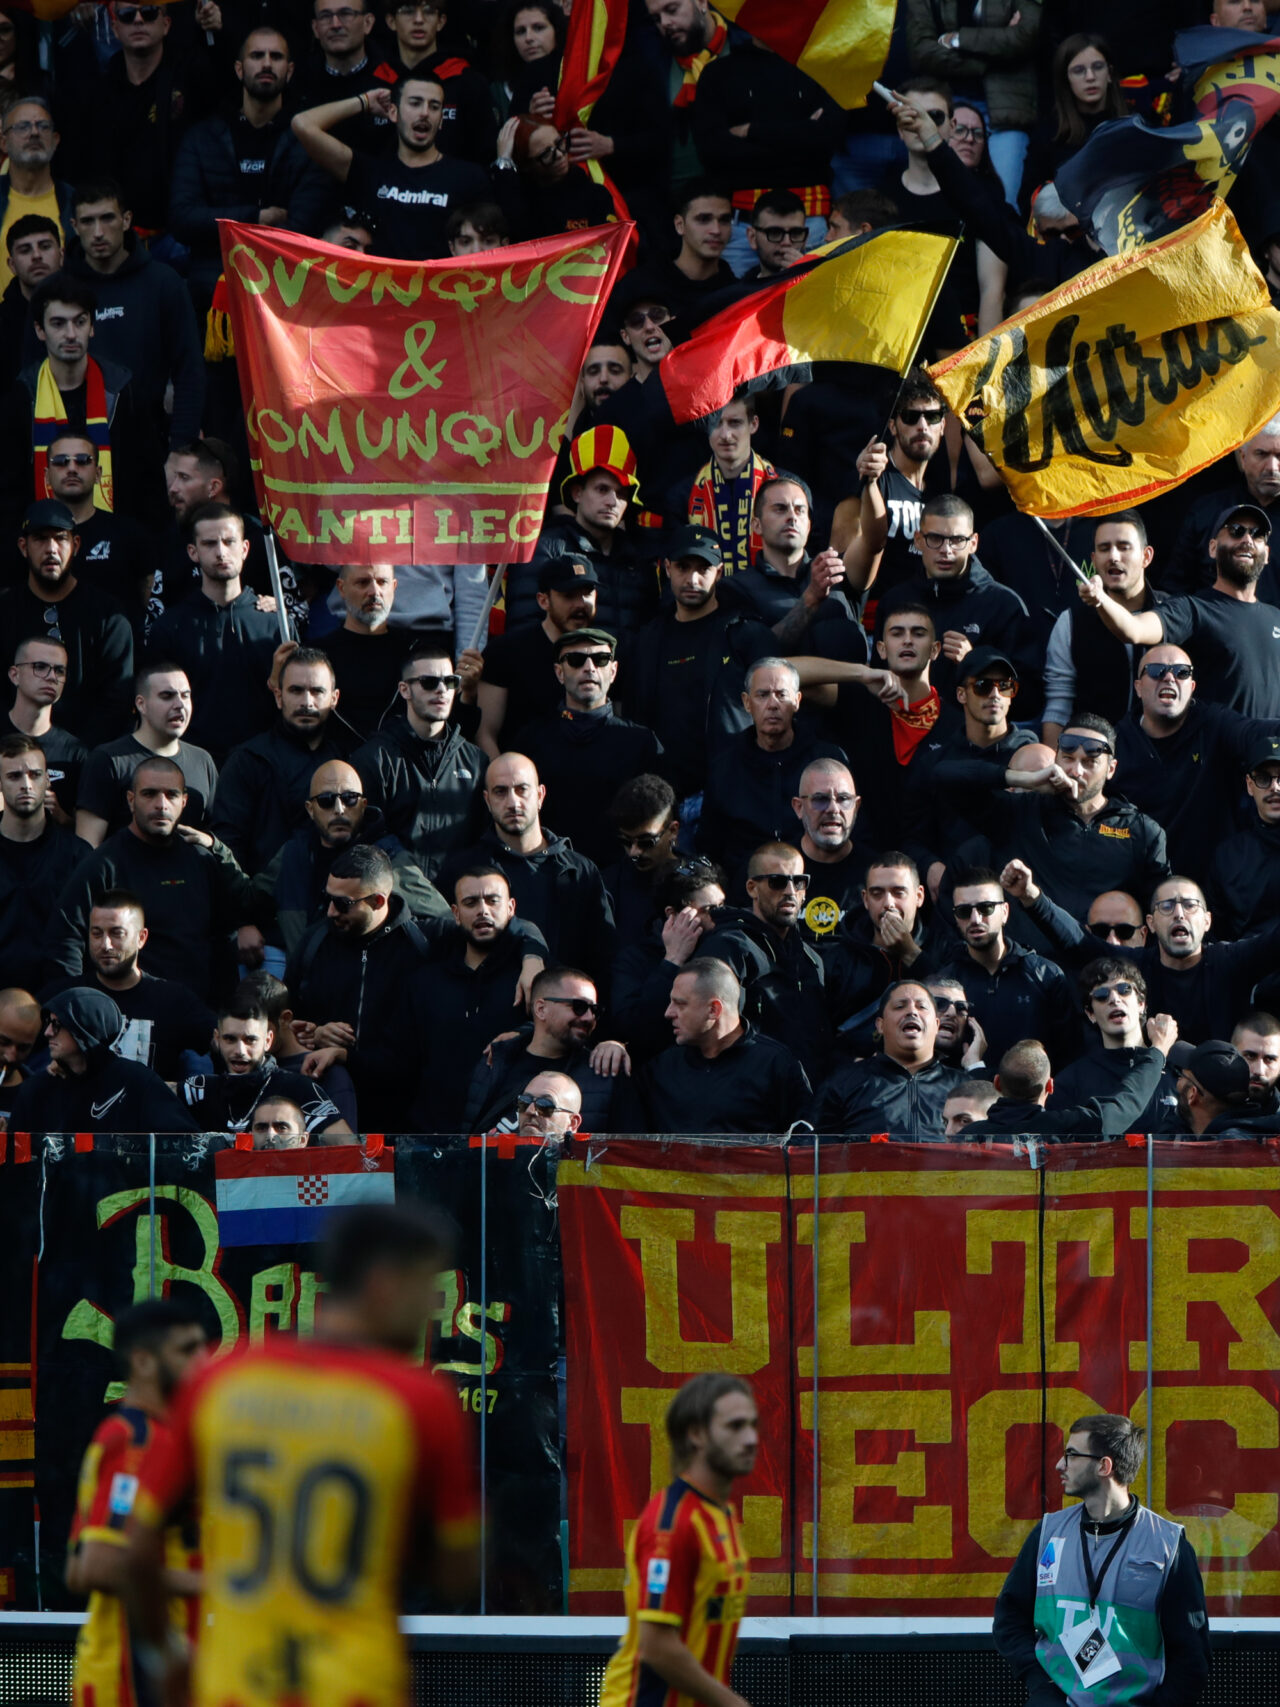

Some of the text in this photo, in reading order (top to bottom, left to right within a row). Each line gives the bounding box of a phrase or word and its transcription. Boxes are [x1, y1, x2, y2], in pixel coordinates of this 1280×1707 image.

[386, 185, 449, 208] Admiral
[228, 242, 610, 312] OVUNQUE
[388, 320, 448, 400] &
[261, 503, 545, 545] VANTI LEC
[458, 1386, 499, 1414] 167
[221, 1447, 374, 1608] 50
